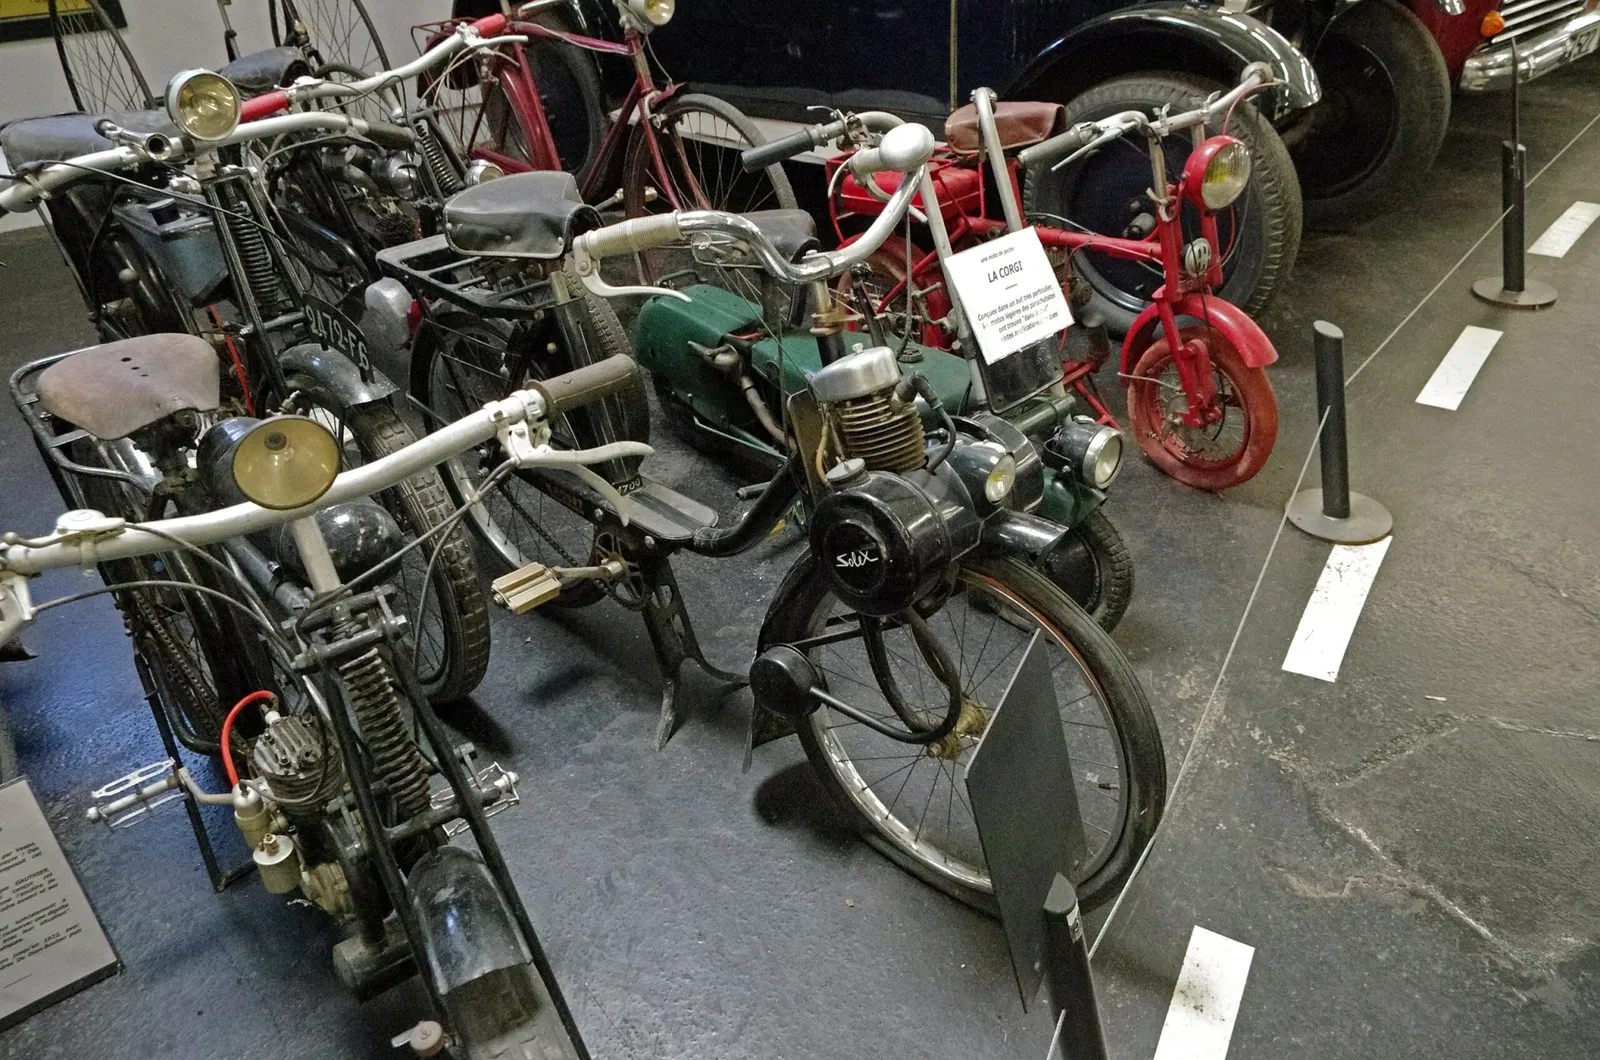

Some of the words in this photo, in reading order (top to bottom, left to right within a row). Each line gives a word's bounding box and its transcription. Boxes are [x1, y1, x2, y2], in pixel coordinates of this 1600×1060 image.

[988, 270, 998, 283] LA
[999, 260, 1023, 278] CORGI
[978, 308, 997, 321] Conçues
[998, 303, 1009, 312] dans
